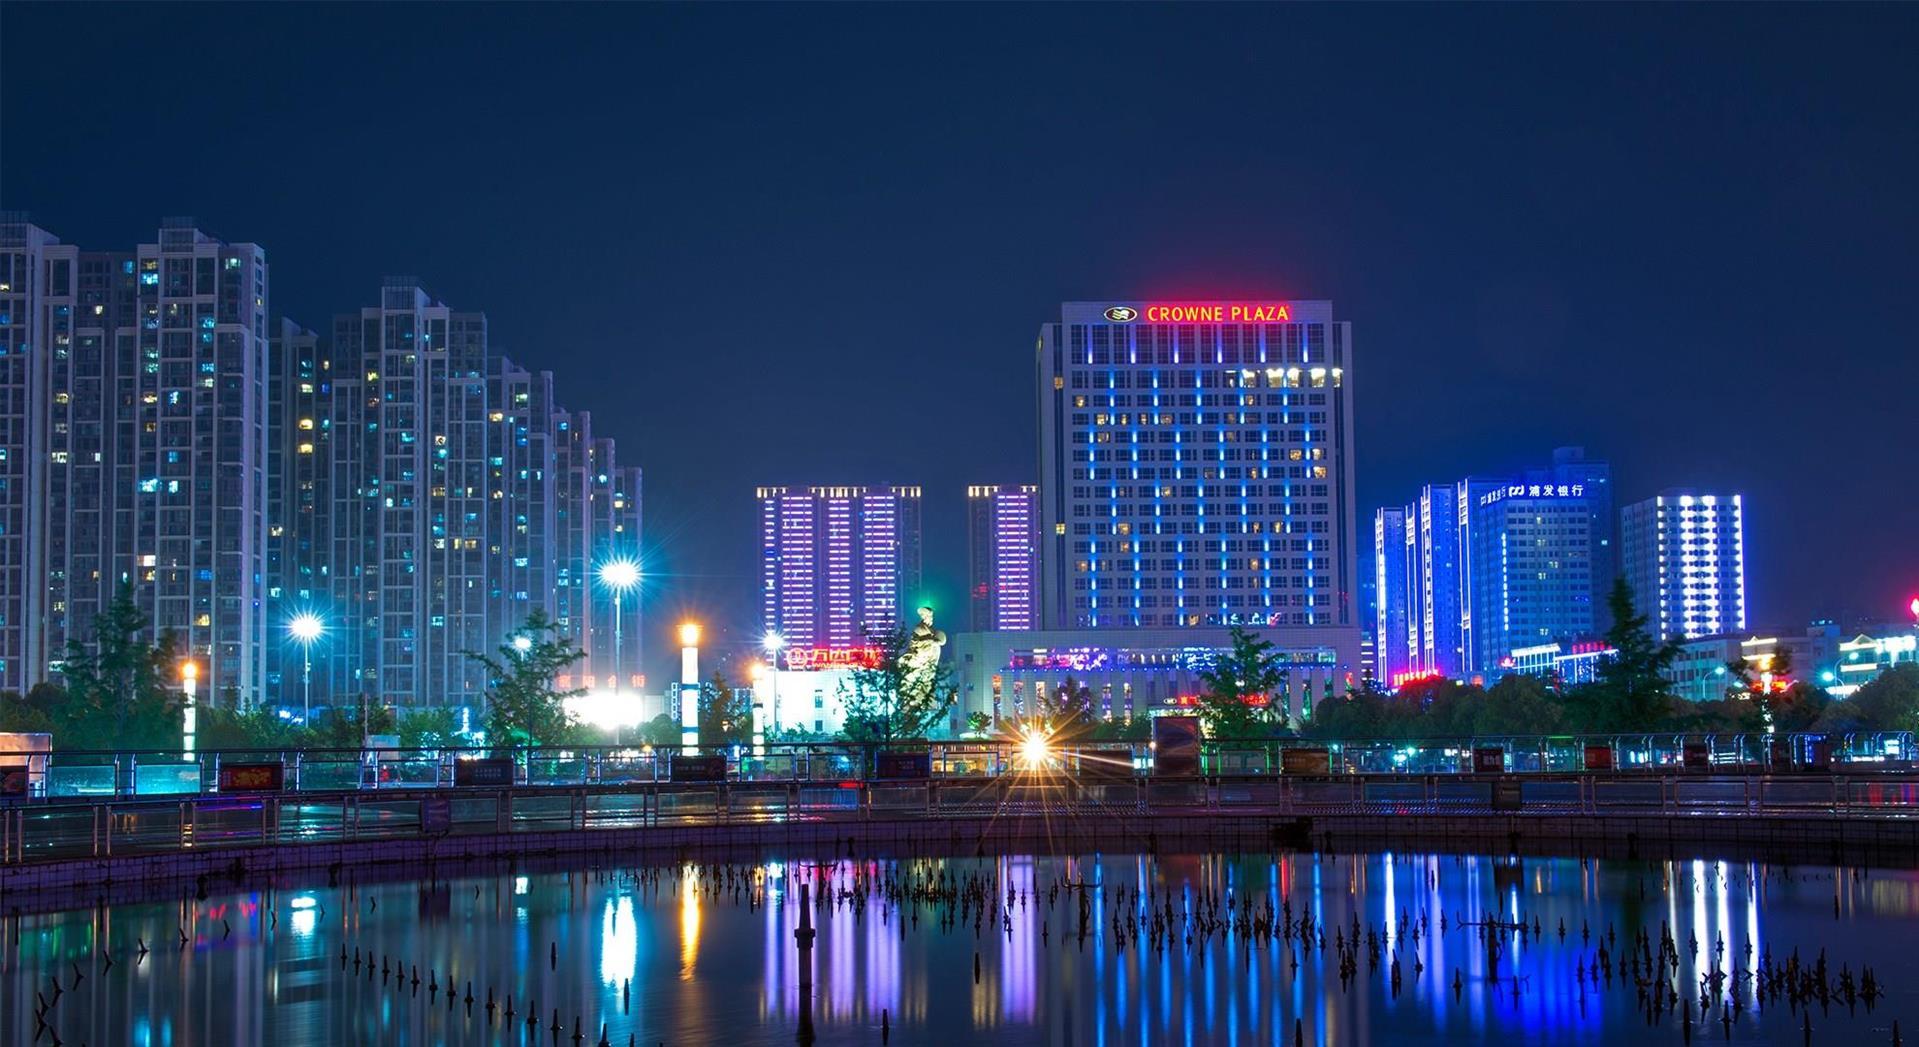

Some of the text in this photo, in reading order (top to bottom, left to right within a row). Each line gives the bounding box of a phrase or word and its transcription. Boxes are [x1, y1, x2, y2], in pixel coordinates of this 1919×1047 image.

[1147, 306, 1289, 321] CROWNE PLAZA
[1528, 484, 1584, 497] 浦发银行
